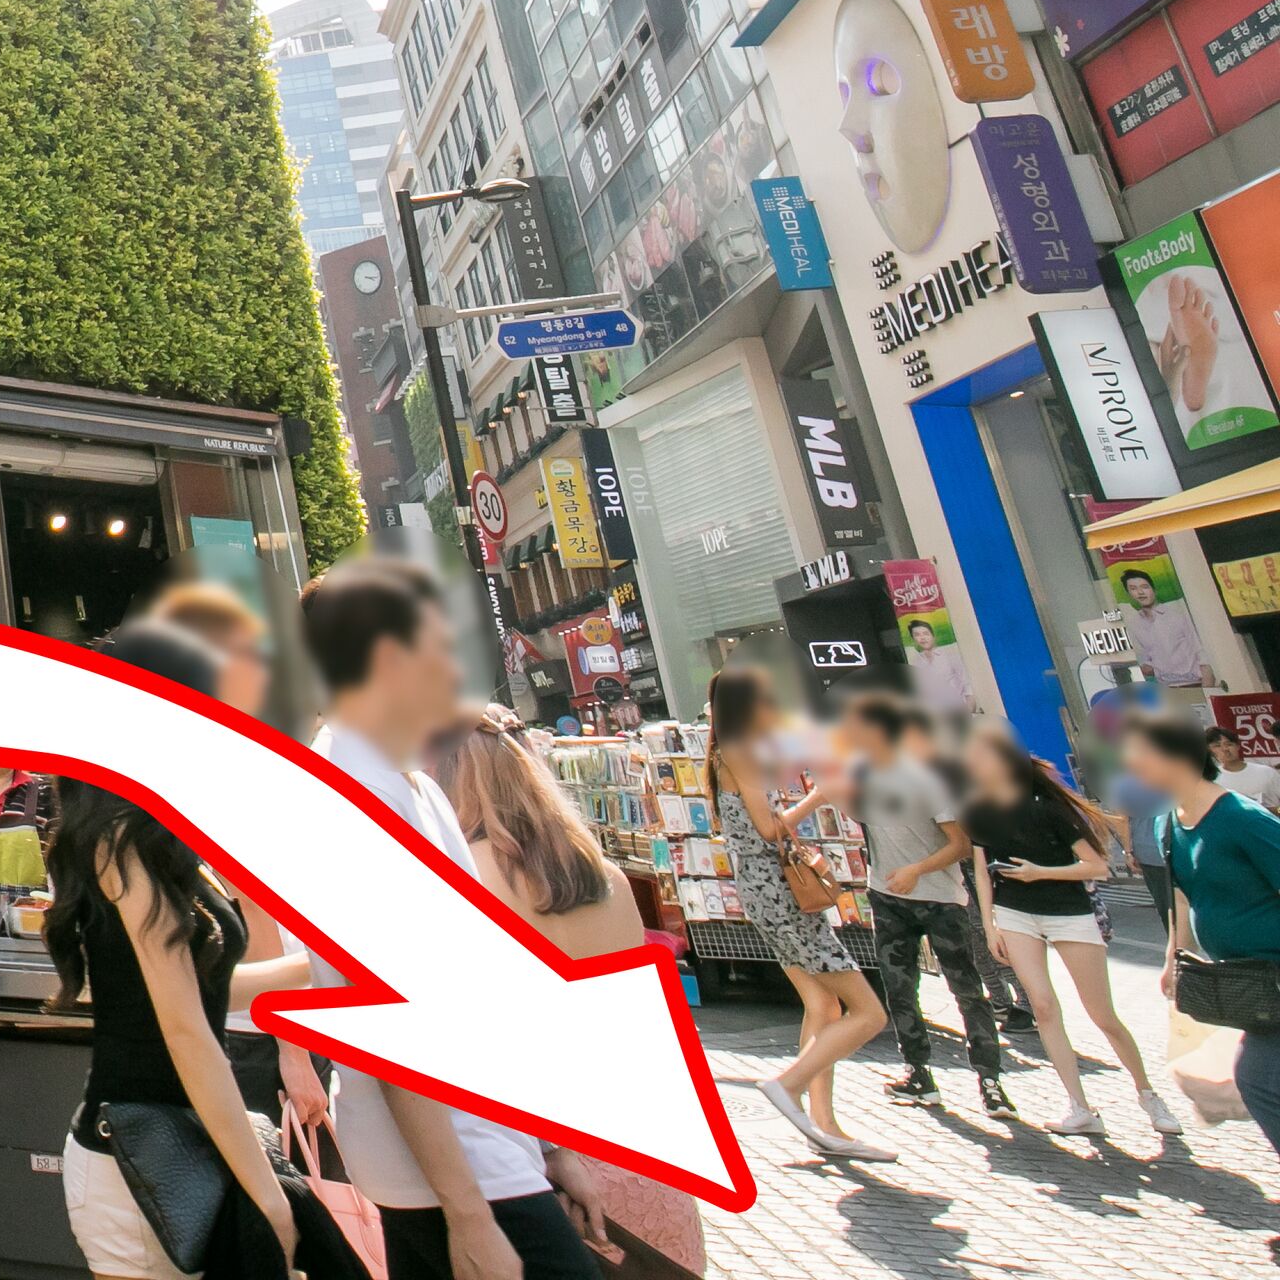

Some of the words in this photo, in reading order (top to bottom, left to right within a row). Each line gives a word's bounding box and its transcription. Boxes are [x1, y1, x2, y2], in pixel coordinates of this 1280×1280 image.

[1012, 152, 1072, 263] 성형외과
[775, 196, 813, 278] MEDIHEAL
[1123, 230, 1196, 278] Foot&Body
[883, 231, 1013, 346] MEDIHEA
[503, 335, 518, 346] 52
[527, 332, 585, 345] Myeongdong
[615, 322, 629, 333] 48
[204, 438, 232, 450] NATURE
[233, 440, 268, 453] REPUBLIC
[798, 415, 858, 509] MLB
[479, 490, 502, 522] 30
[595, 467, 625, 518] IOPE
[555, 478, 588, 554] 황금목장
[700, 526, 730, 556] IOPE
[817, 550, 851, 587] MLB
[893, 582, 939, 607] Spring
[1081, 626, 1133, 656] MEDIH
[1229, 704, 1273, 715] TOURIST
